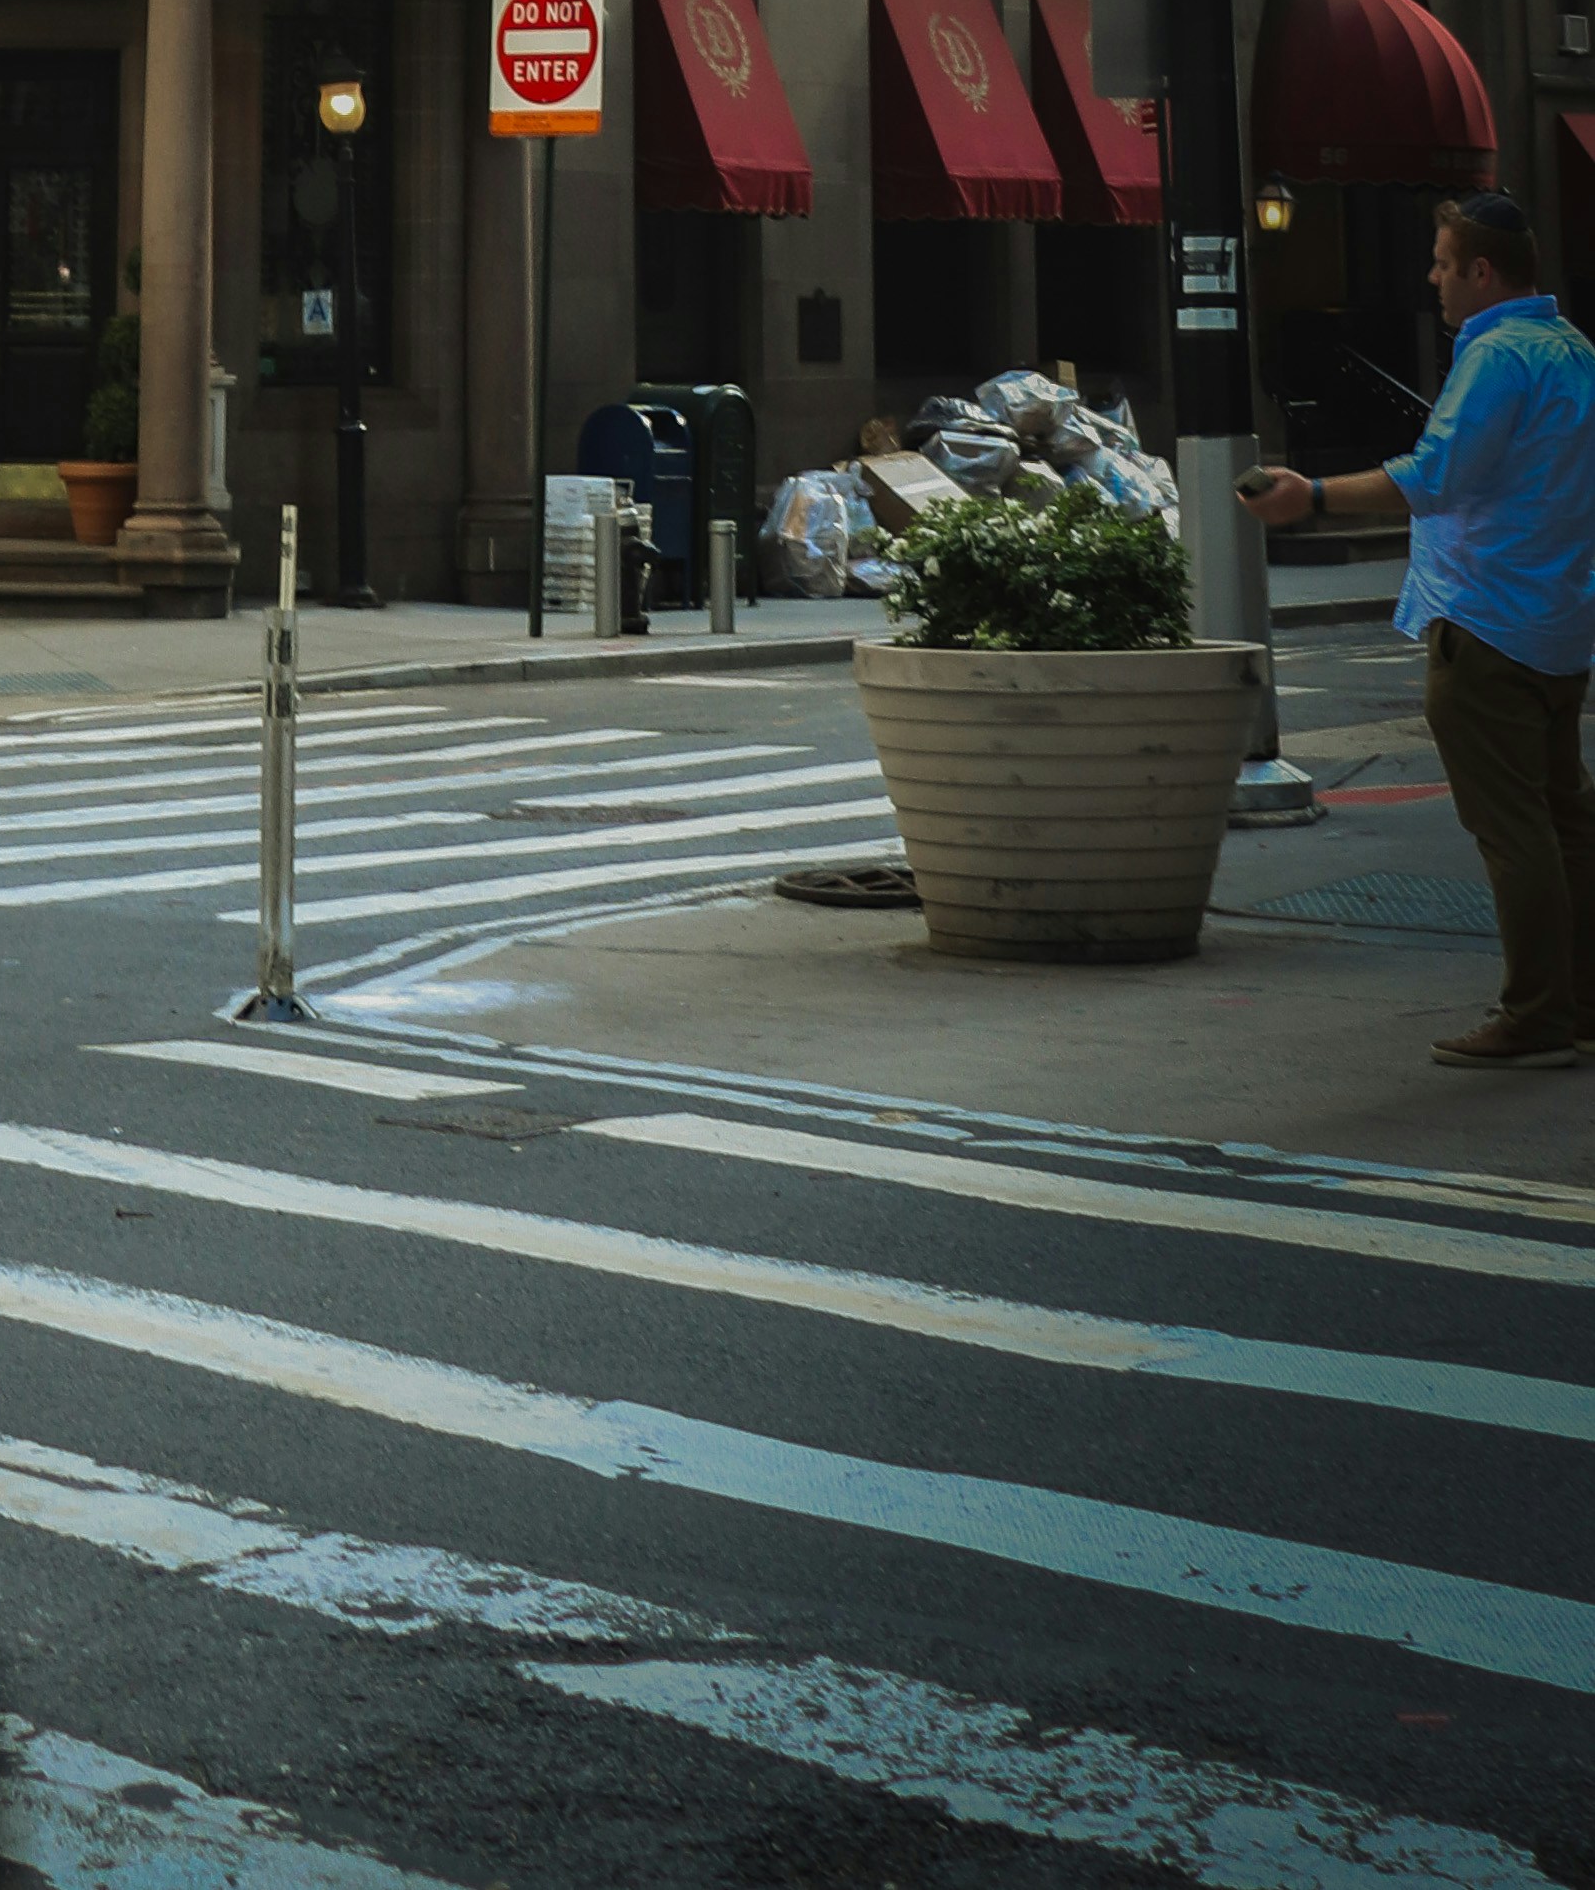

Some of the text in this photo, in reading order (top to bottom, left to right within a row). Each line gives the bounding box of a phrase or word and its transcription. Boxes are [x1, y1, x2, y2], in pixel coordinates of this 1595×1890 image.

[512, 0, 584, 25] DO NOT
[513, 60, 580, 83] ENTER
[308, 296, 327, 322] A
